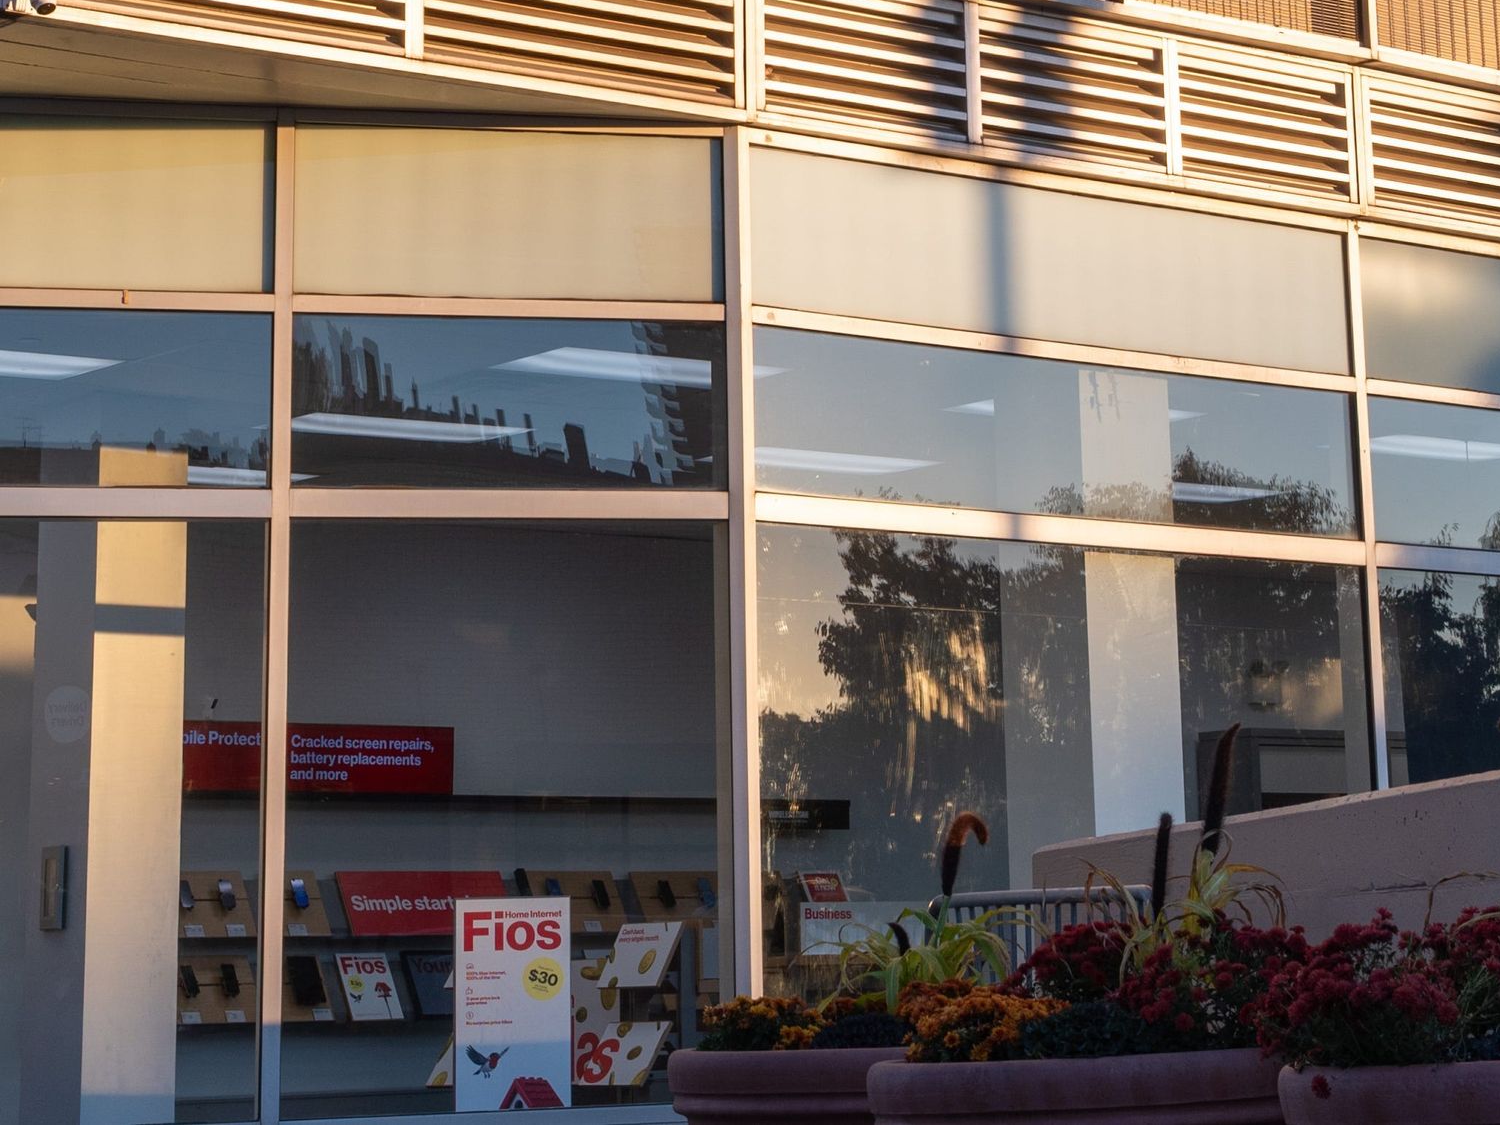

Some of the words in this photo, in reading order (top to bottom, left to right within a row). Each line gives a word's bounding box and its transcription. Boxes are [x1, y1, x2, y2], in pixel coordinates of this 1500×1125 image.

[208, 731, 261, 746] Protect
[291, 734, 343, 749] Cracked
[345, 737, 387, 750] screen
[389, 737, 434, 753] repairs,
[290, 751, 337, 767] battery
[338, 753, 421, 767] replacements
[290, 768, 314, 780] and
[316, 770, 348, 781] more
[351, 894, 413, 913] Simple
[415, 895, 455, 911] start
[505, 910, 528, 918] Home
[530, 909, 562, 918] Internet
[804, 908, 852, 920] Business
[463, 910, 562, 952] Fios
[339, 955, 387, 975] Fios
[528, 968, 558, 986] $30
